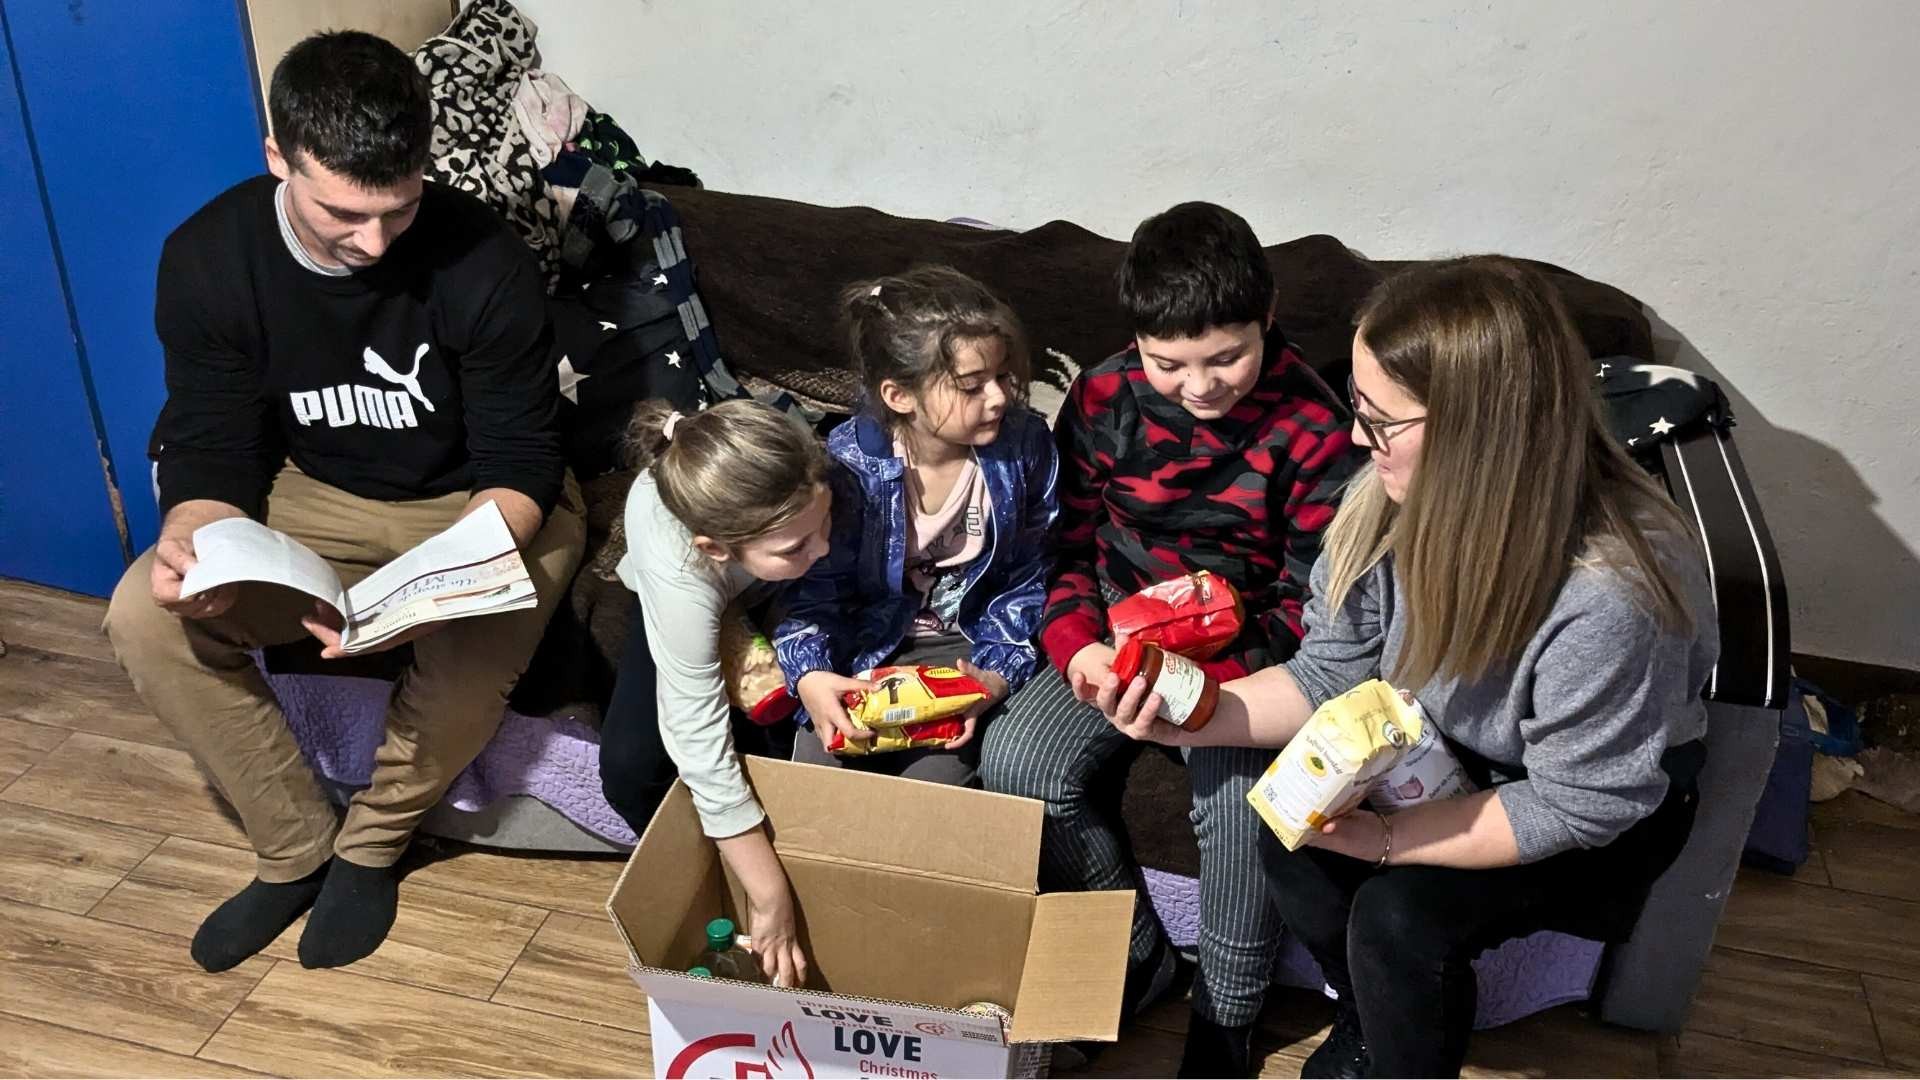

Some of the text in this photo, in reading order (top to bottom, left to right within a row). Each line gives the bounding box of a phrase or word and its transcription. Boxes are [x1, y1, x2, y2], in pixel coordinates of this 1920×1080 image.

[290, 384, 418, 429] PUMA
[801, 1006, 894, 1028] LOVE
[834, 1026, 922, 1062] LOVE
[859, 1059, 938, 1079] Christmas
